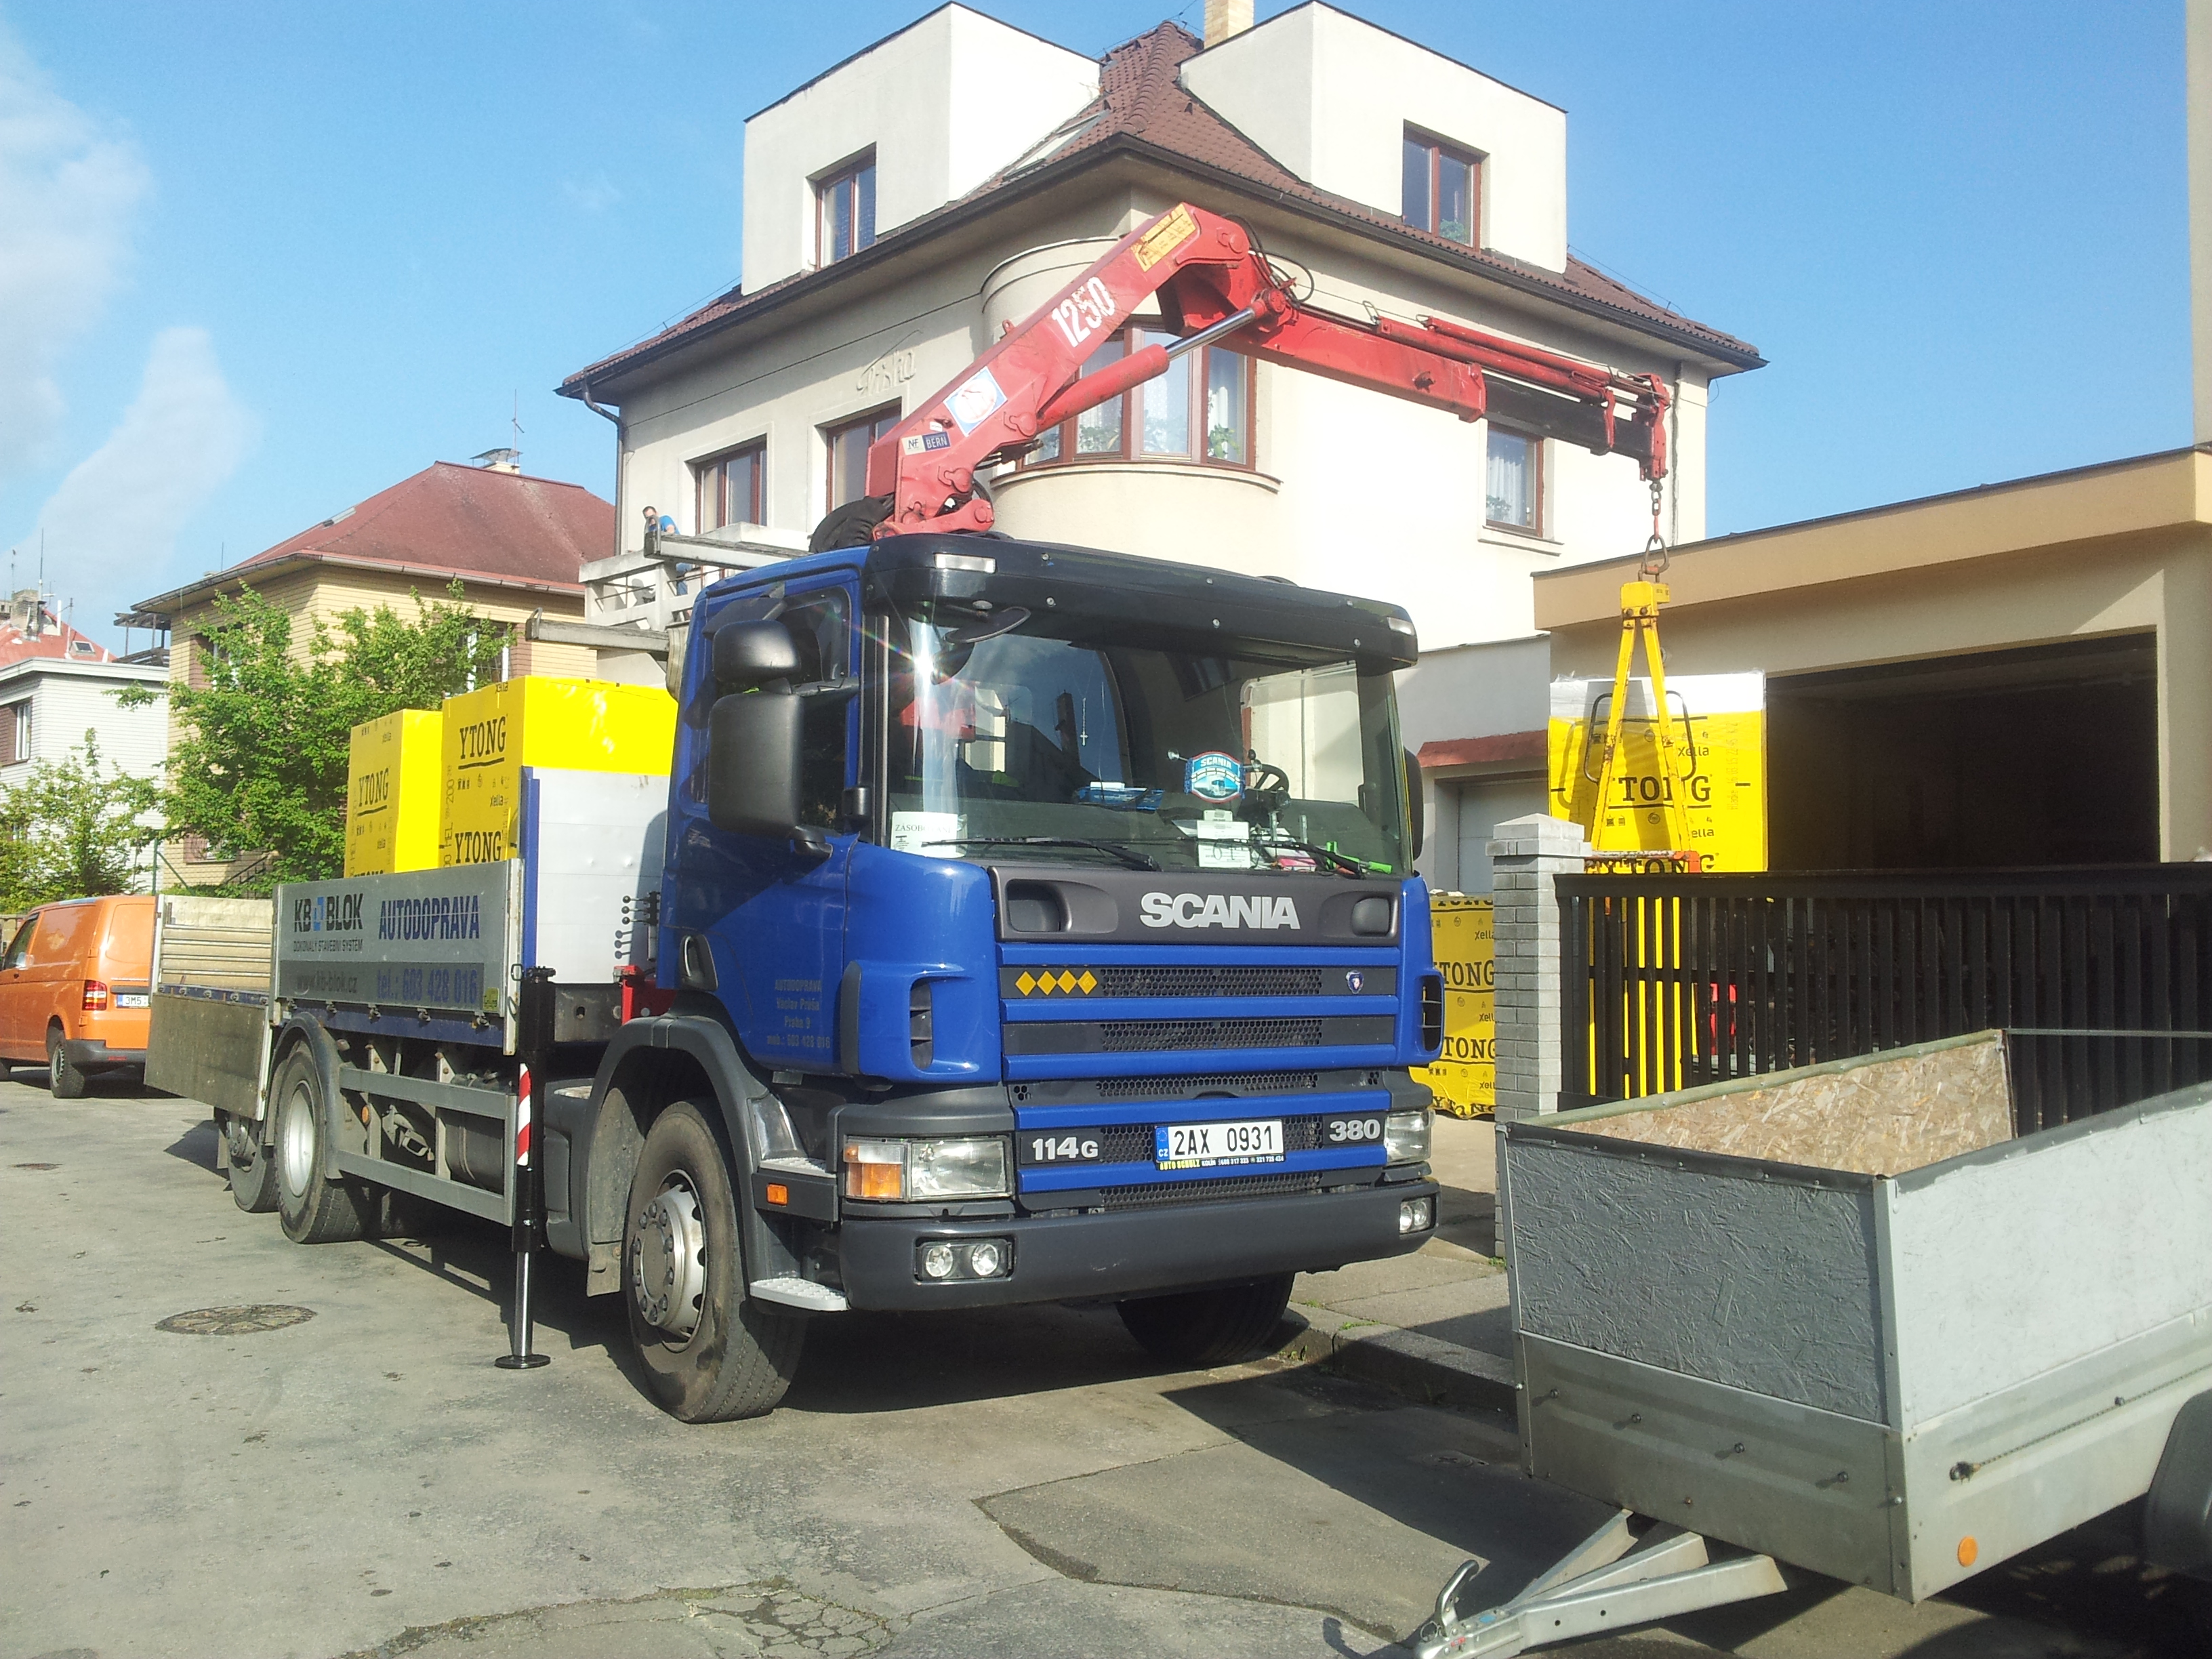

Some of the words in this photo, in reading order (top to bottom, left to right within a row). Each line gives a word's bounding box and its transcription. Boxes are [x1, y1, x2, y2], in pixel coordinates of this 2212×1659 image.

[1051, 276, 1115, 348] 1250
[926, 436, 948, 449] BERN
[459, 716, 506, 760] YTONG
[1200, 756, 1232, 770] SCANIA
[359, 767, 390, 807] YTONG
[1609, 776, 1711, 802] TOG
[455, 831, 501, 864] YTONG
[1692, 828, 1715, 838] ella
[293, 898, 312, 933] KB
[325, 893, 364, 931] BLOK
[377, 895, 480, 941] AUTODOPRAVA
[1140, 892, 1301, 930] SCANIA
[428, 968, 450, 1003] 428
[454, 968, 478, 1004] 016
[1433, 960, 1494, 987] TONG
[1444, 1036, 1495, 1059] TONG
[1174, 1128, 1210, 1156] 2AX
[1227, 1125, 1273, 1152] 0931
[1329, 1119, 1380, 1142] 380
[1158, 1148, 1168, 1158] CZ
[1160, 1161, 1176, 1170] AUTO
[1176, 1159, 1200, 1169] SCHULZ
